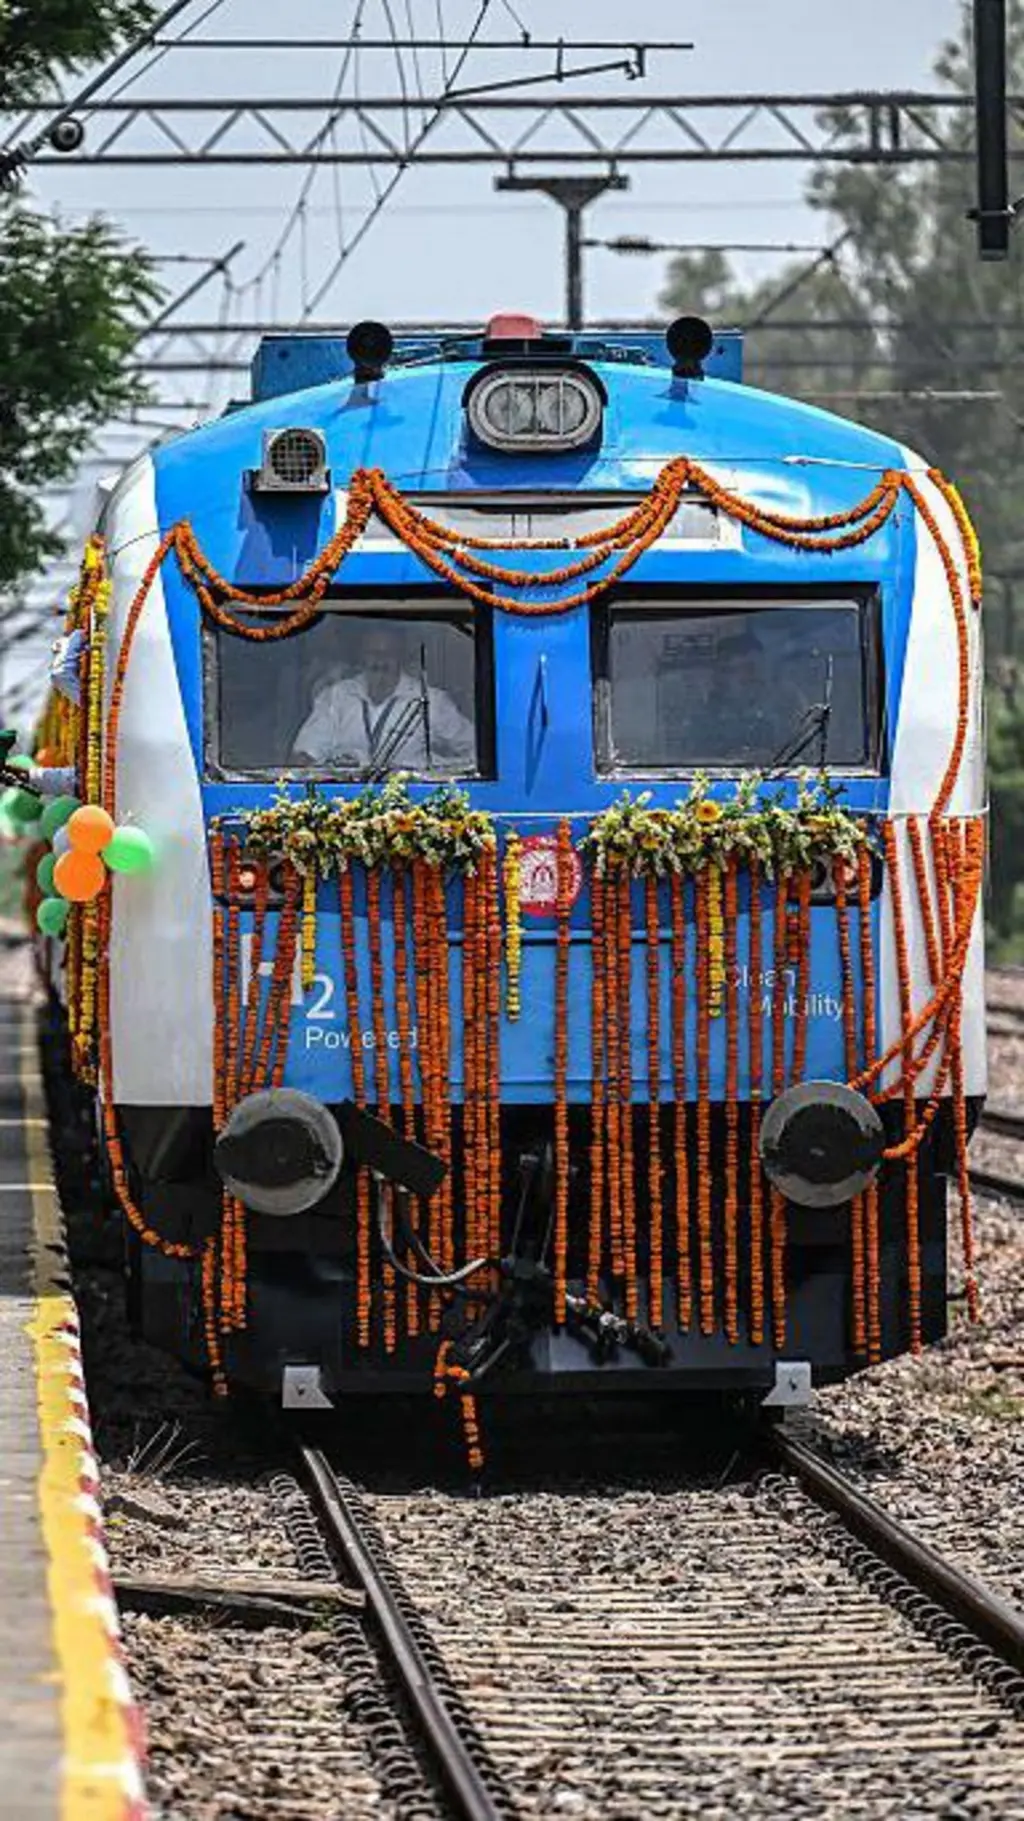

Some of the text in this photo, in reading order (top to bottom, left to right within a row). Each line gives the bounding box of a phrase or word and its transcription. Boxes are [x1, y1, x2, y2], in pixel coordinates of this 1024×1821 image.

[240, 933, 336, 1019] H2
[727, 964, 796, 987] lan
[757, 994, 843, 1021] Mbility
[305, 1026, 417, 1048] Poeed
